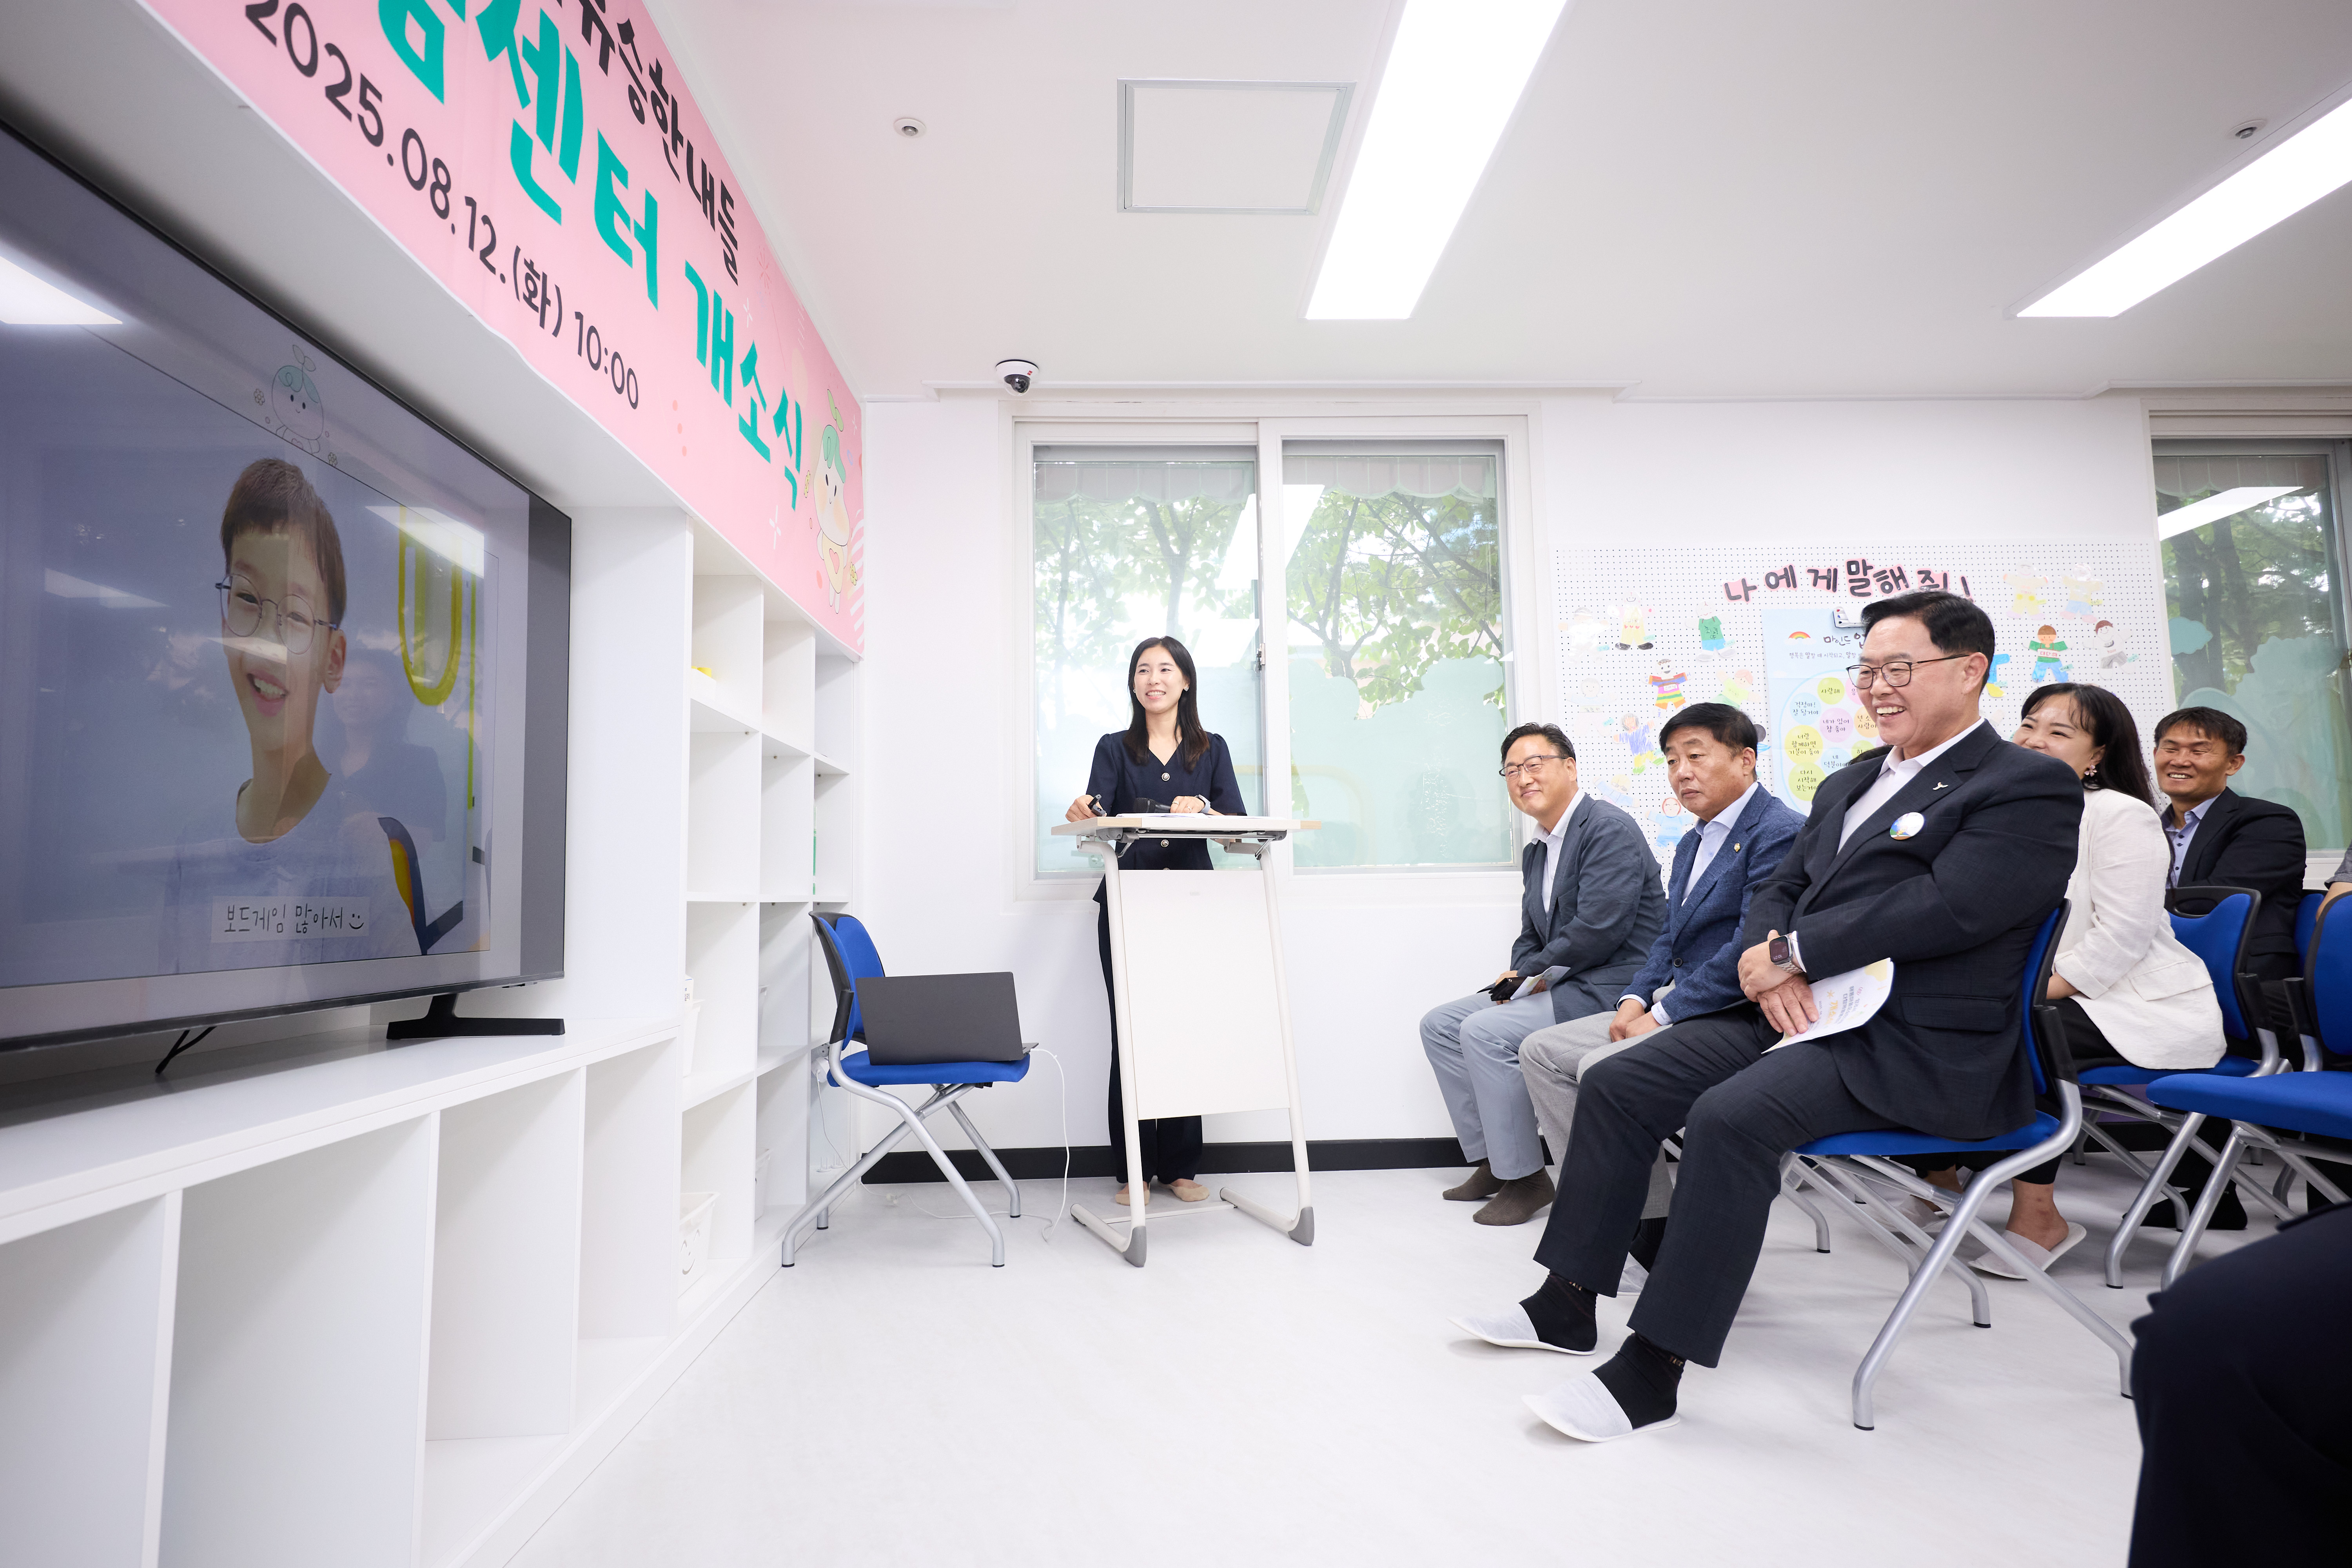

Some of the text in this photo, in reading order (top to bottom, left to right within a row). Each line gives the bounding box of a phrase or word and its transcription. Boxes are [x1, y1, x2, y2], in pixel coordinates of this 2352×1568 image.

[574, 310, 639, 410] 10:00
[685, 259, 802, 510] 개소식
[1823, 635, 1851, 646] 마인드
[225, 902, 344, 934] 보드게임 많아서
